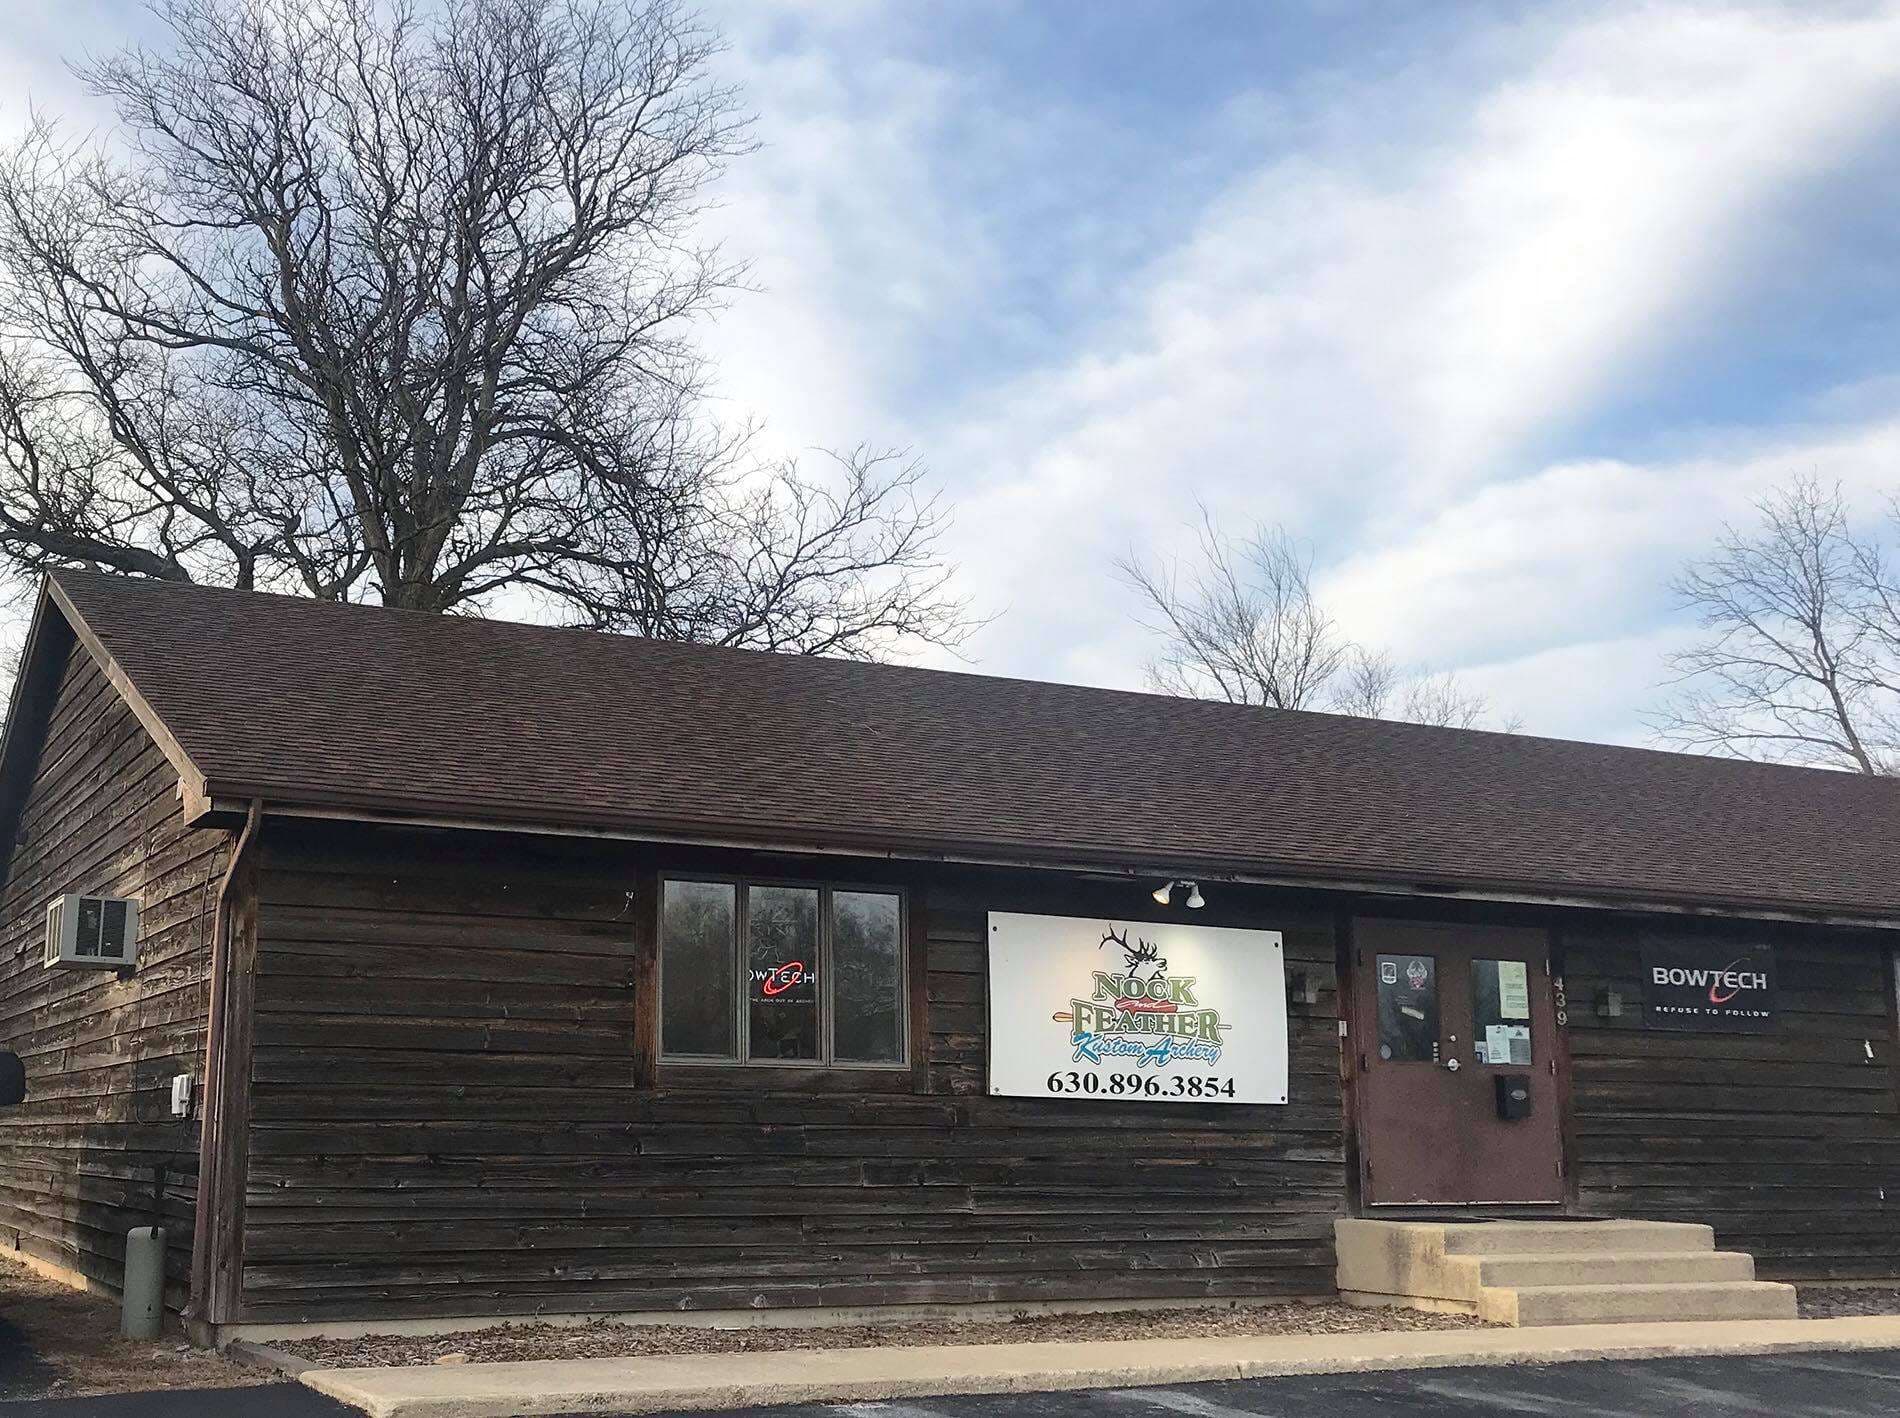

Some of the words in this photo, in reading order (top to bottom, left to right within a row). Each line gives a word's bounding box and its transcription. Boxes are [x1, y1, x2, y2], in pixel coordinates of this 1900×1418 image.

[749, 968, 815, 984] OWTECH
[1092, 971, 1198, 1006] NOCK
[1652, 967, 1767, 989] BOWTECH
[1553, 977, 1567, 1026] 439
[1655, 1006, 1699, 1014] REFUSE
[1725, 1009, 1770, 1017] FOLLOW
[1071, 998, 1223, 1045] FEATHER
[1071, 1031, 1145, 1064] Kustom
[1137, 1036, 1221, 1068] Archery
[1047, 1071, 1236, 1098] 630.896.3854
